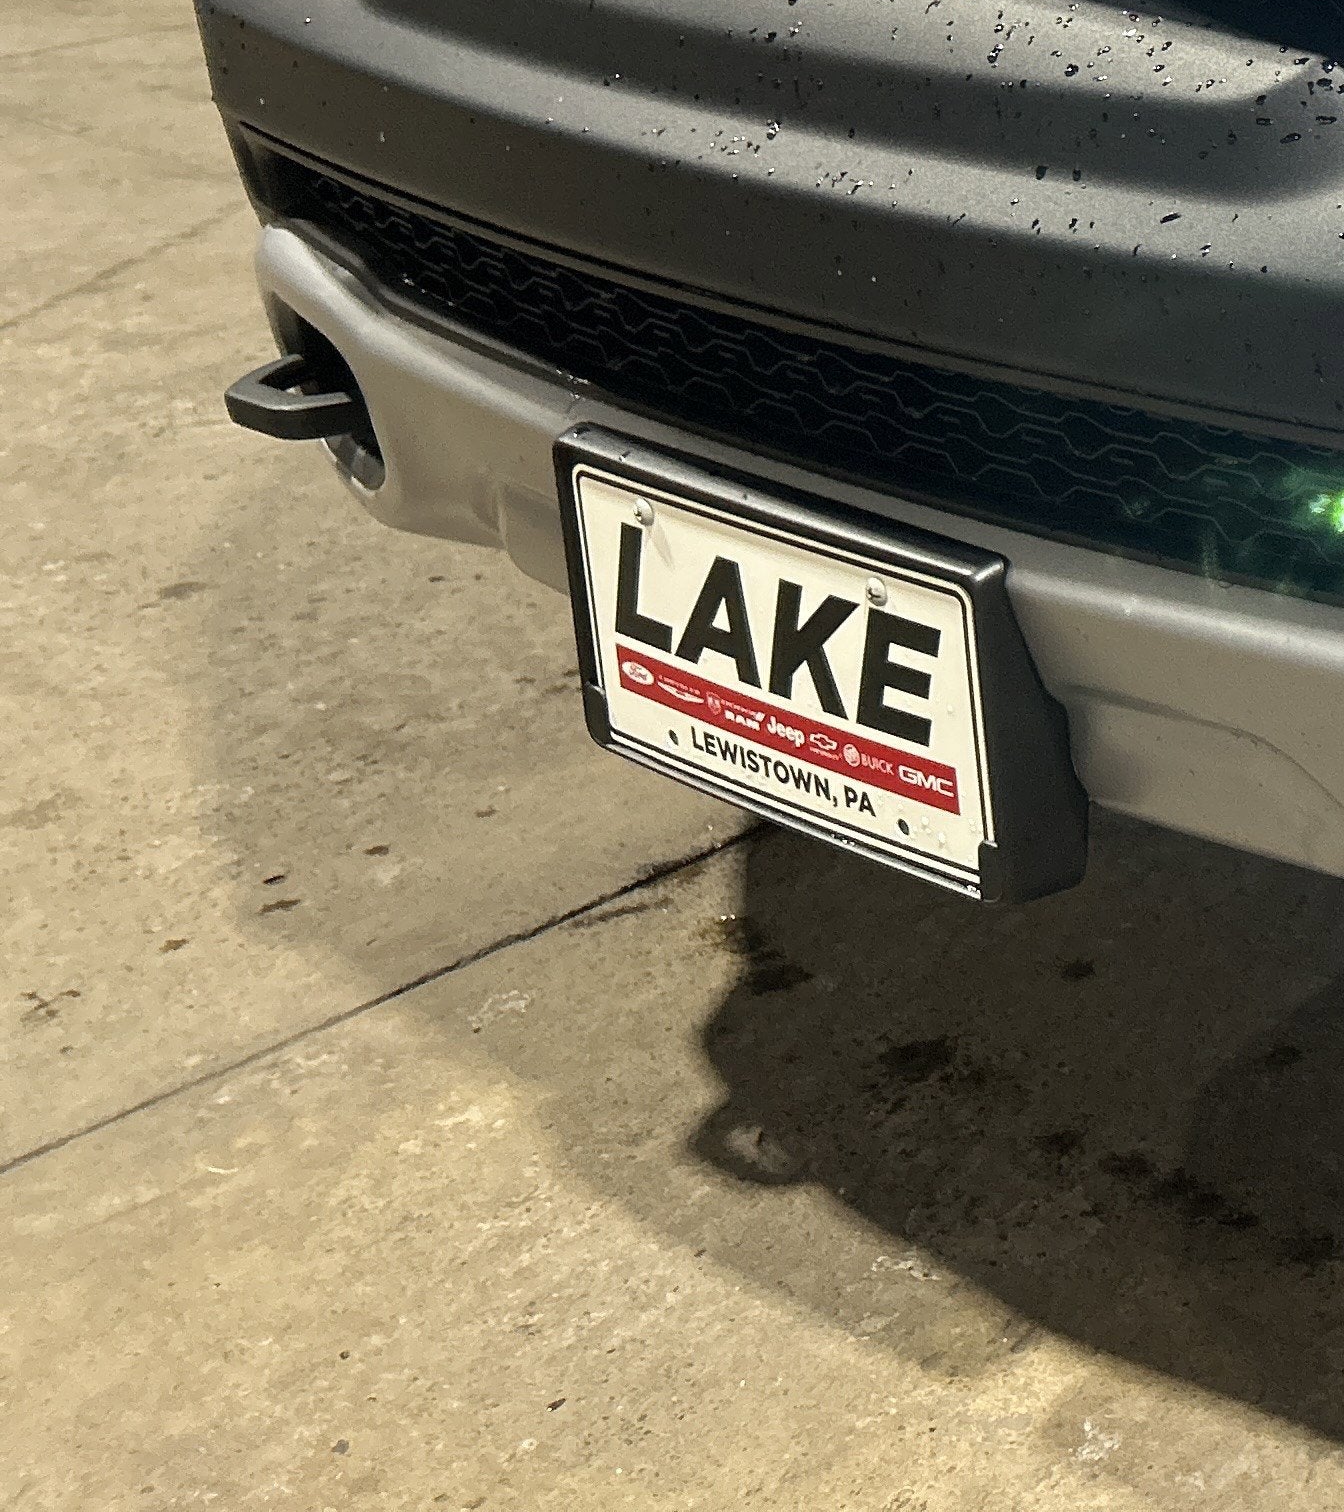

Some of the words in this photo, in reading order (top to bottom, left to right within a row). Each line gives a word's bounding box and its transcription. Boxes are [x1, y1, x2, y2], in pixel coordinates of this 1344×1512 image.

[615, 521, 942, 748] LAKE
[690, 725, 839, 808] LEWISTOWN,
[843, 784, 877, 818] PA
[766, 715, 805, 748] Jeep
[860, 753, 895, 776] BUICK
[898, 764, 955, 798] GMC
